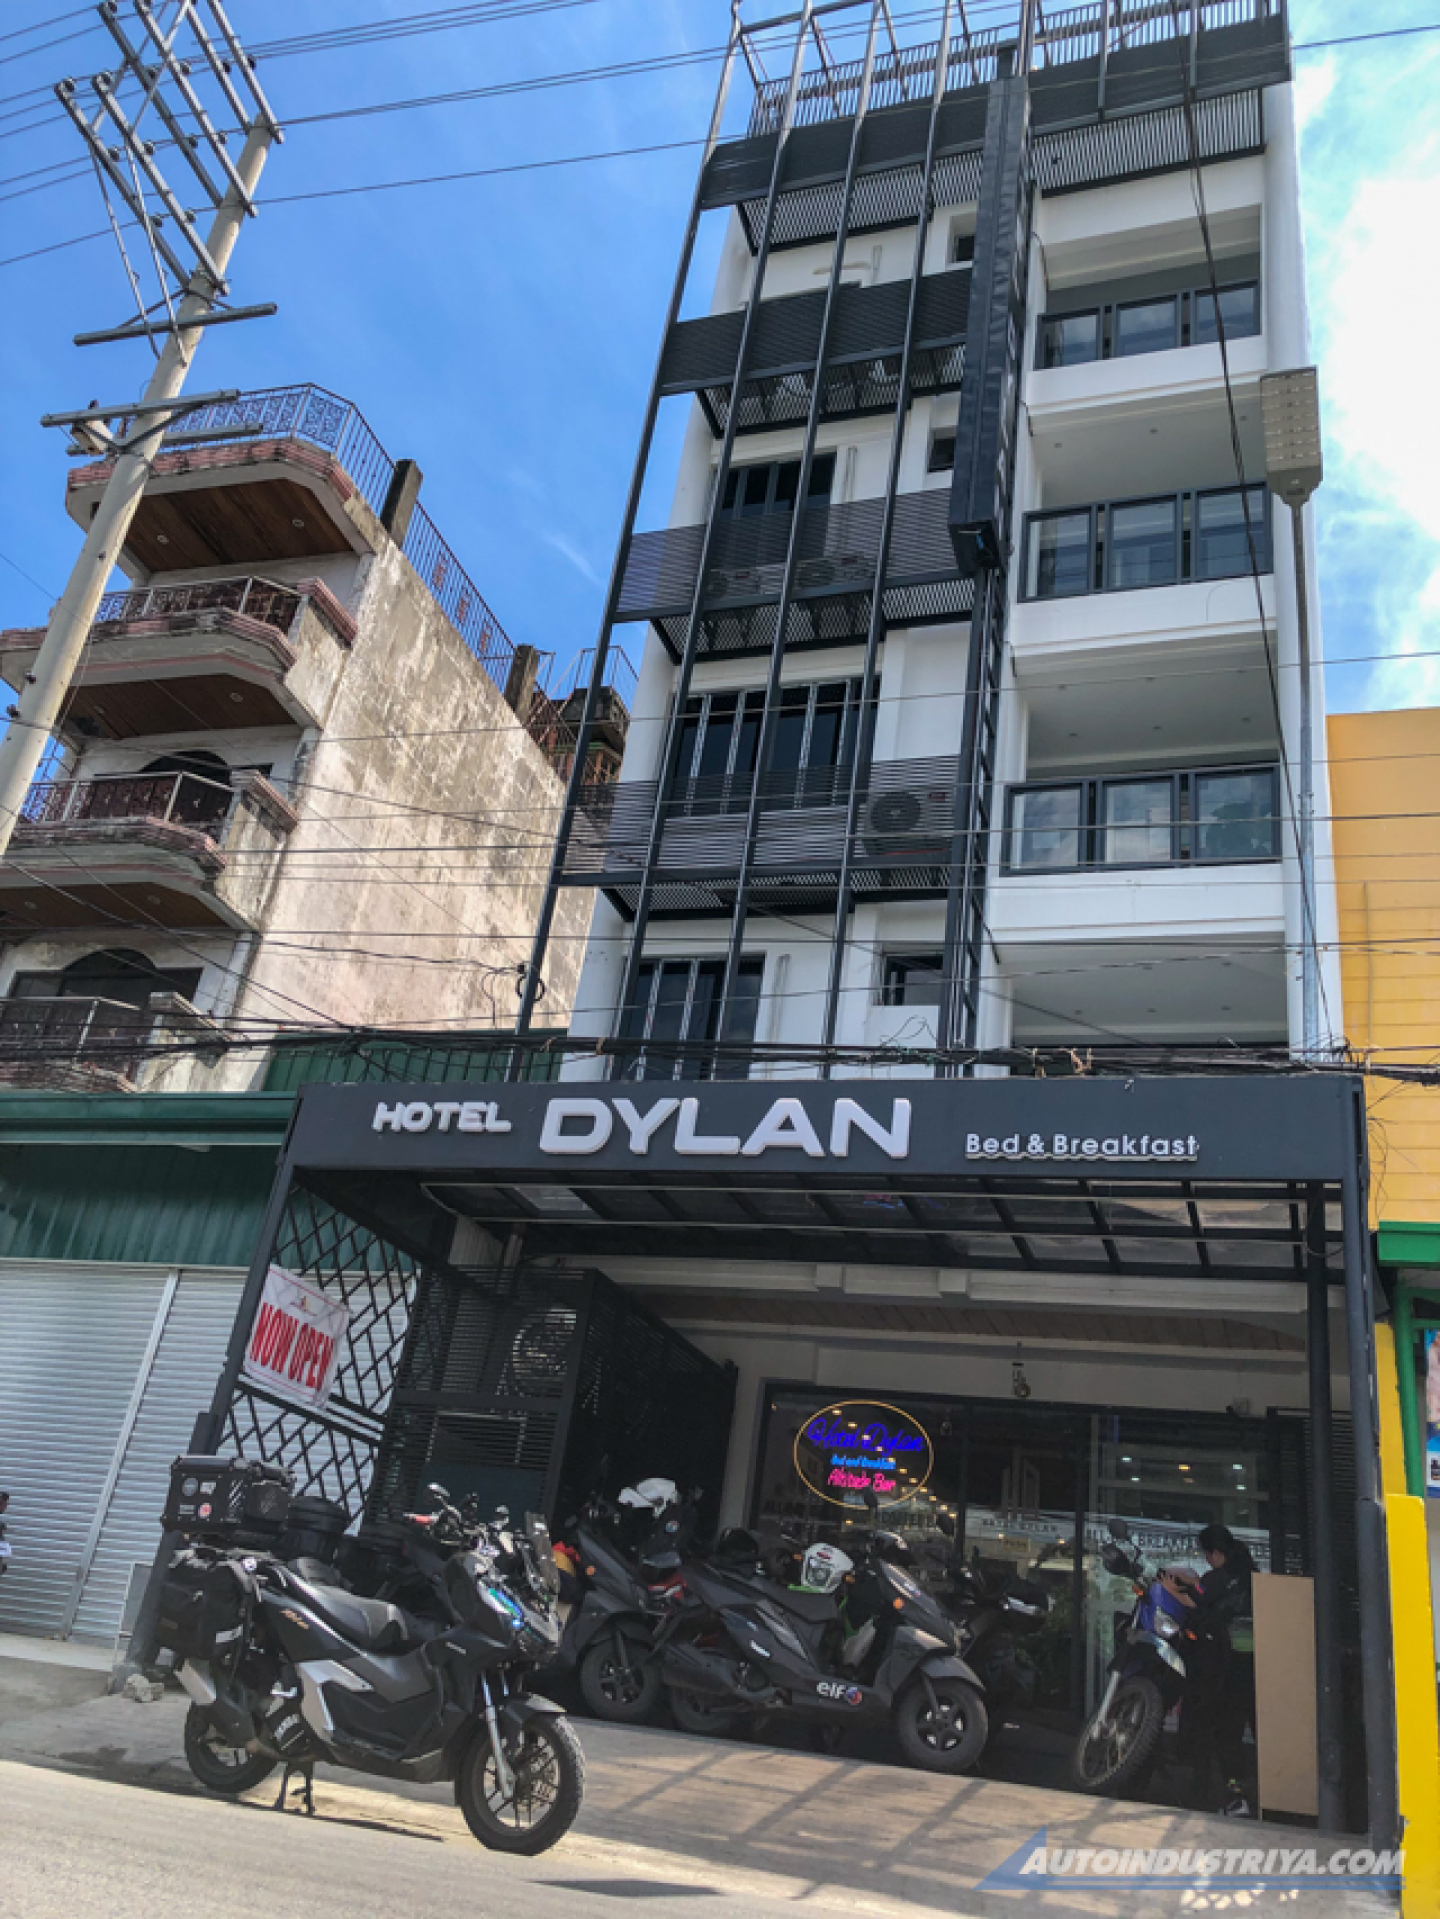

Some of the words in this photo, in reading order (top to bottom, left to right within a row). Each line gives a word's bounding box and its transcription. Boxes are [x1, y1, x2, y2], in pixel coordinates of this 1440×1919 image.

[372, 1101, 511, 1133] HOTEL
[538, 1096, 912, 1158] DYLAN
[965, 1133, 1020, 1156] Bed
[1026, 1134, 1045, 1157] &
[1053, 1133, 1198, 1158] Breakfast
[250, 1302, 299, 1373] NOW
[288, 1323, 334, 1391] OPEN
